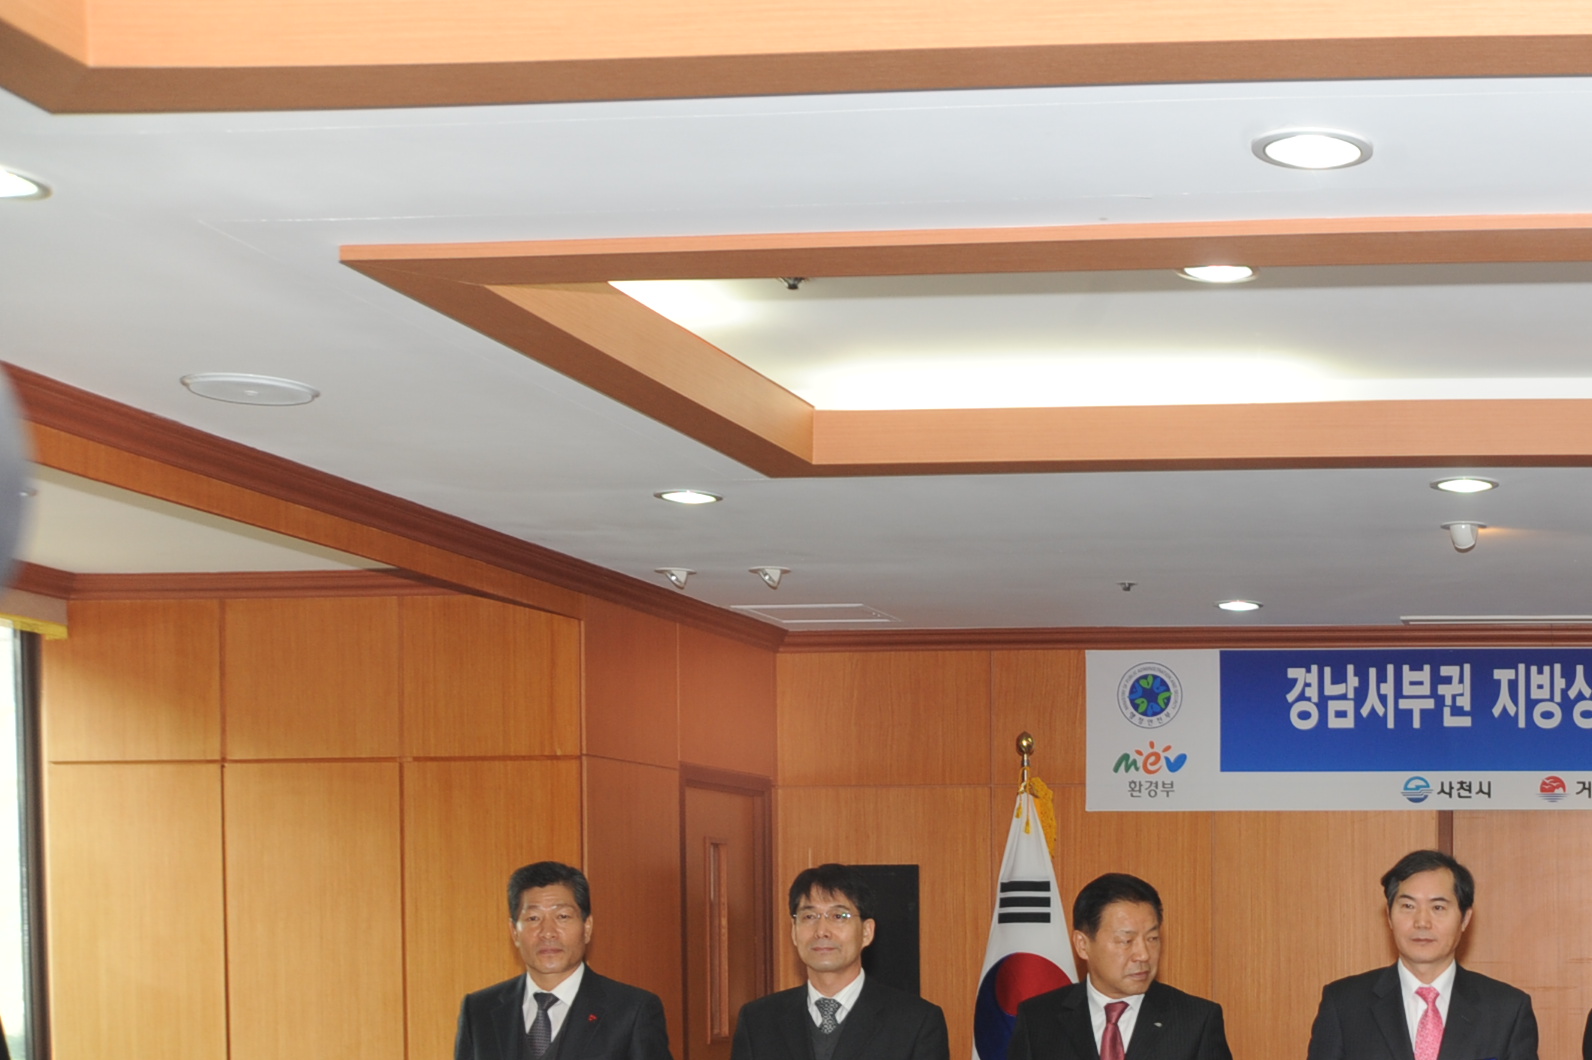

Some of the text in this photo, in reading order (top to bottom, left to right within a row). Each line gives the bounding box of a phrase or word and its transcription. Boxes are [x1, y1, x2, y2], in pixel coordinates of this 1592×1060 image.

[1285, 663, 1472, 730] 경남서부권
[1128, 780, 1175, 798] 환경부
[1437, 781, 1492, 799] 사천시
